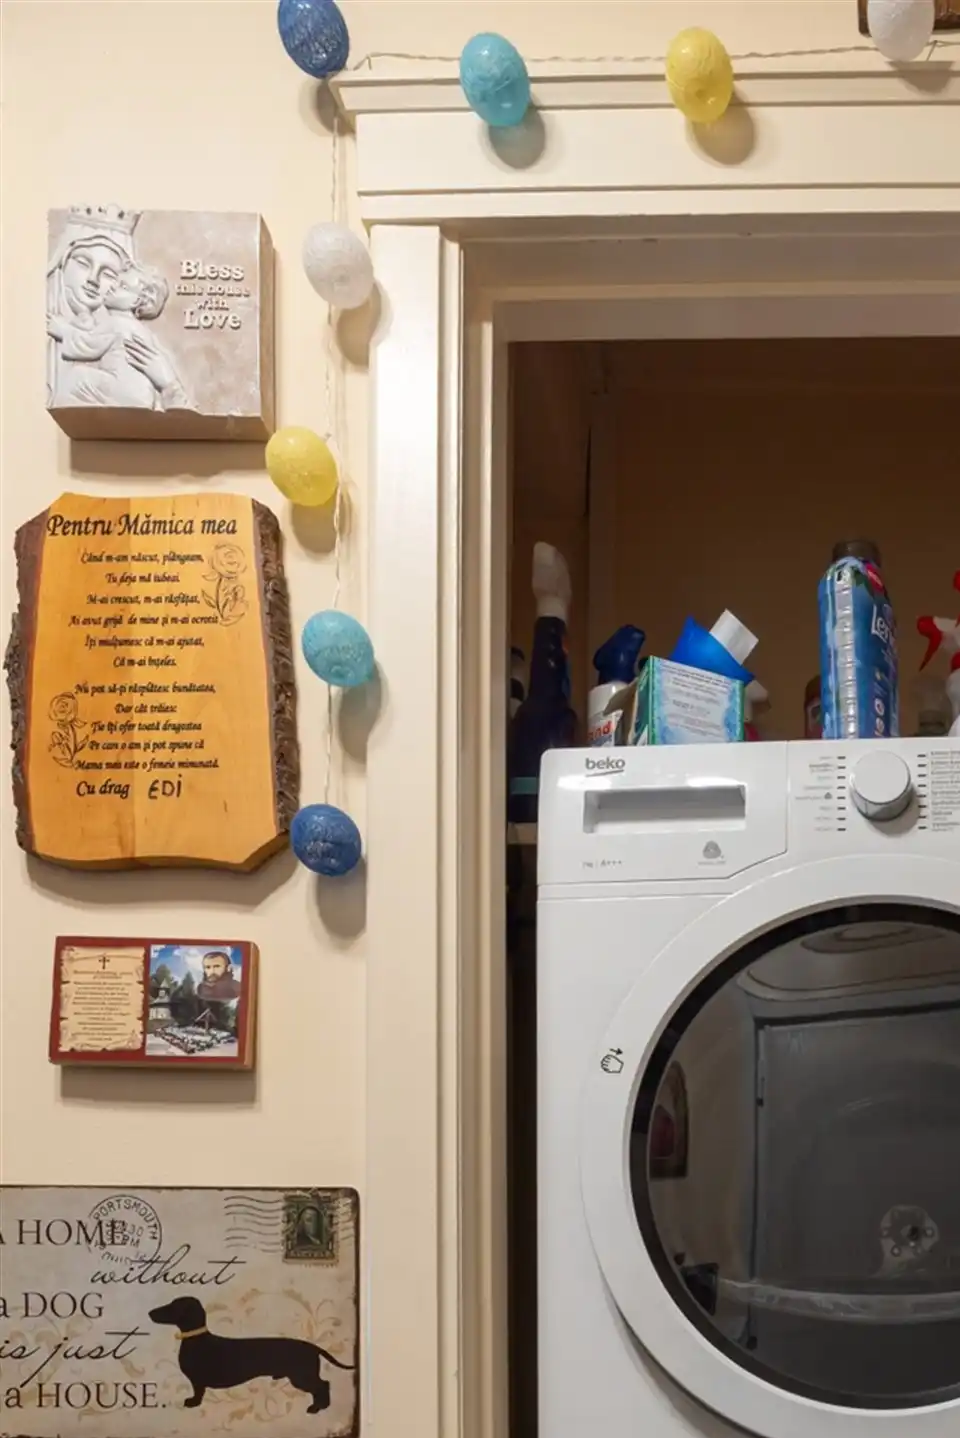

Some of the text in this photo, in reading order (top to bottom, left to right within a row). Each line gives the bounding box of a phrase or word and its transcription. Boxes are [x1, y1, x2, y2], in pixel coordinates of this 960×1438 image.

[180, 259, 245, 281] Bless
[183, 309, 242, 330] Love
[47, 512, 238, 537] Pentru Mămica mea
[585, 757, 626, 771] beko
[76, 778, 131, 800] Cu drag
[93, 1198, 158, 1240] PORTSMOUTH
[18, 1218, 129, 1247] HOME
[90, 1244, 247, 1286] without
[22, 1292, 105, 1318] DOG
[21, 1327, 150, 1388] just
[5, 1381, 166, 1409] a HOUSE.
